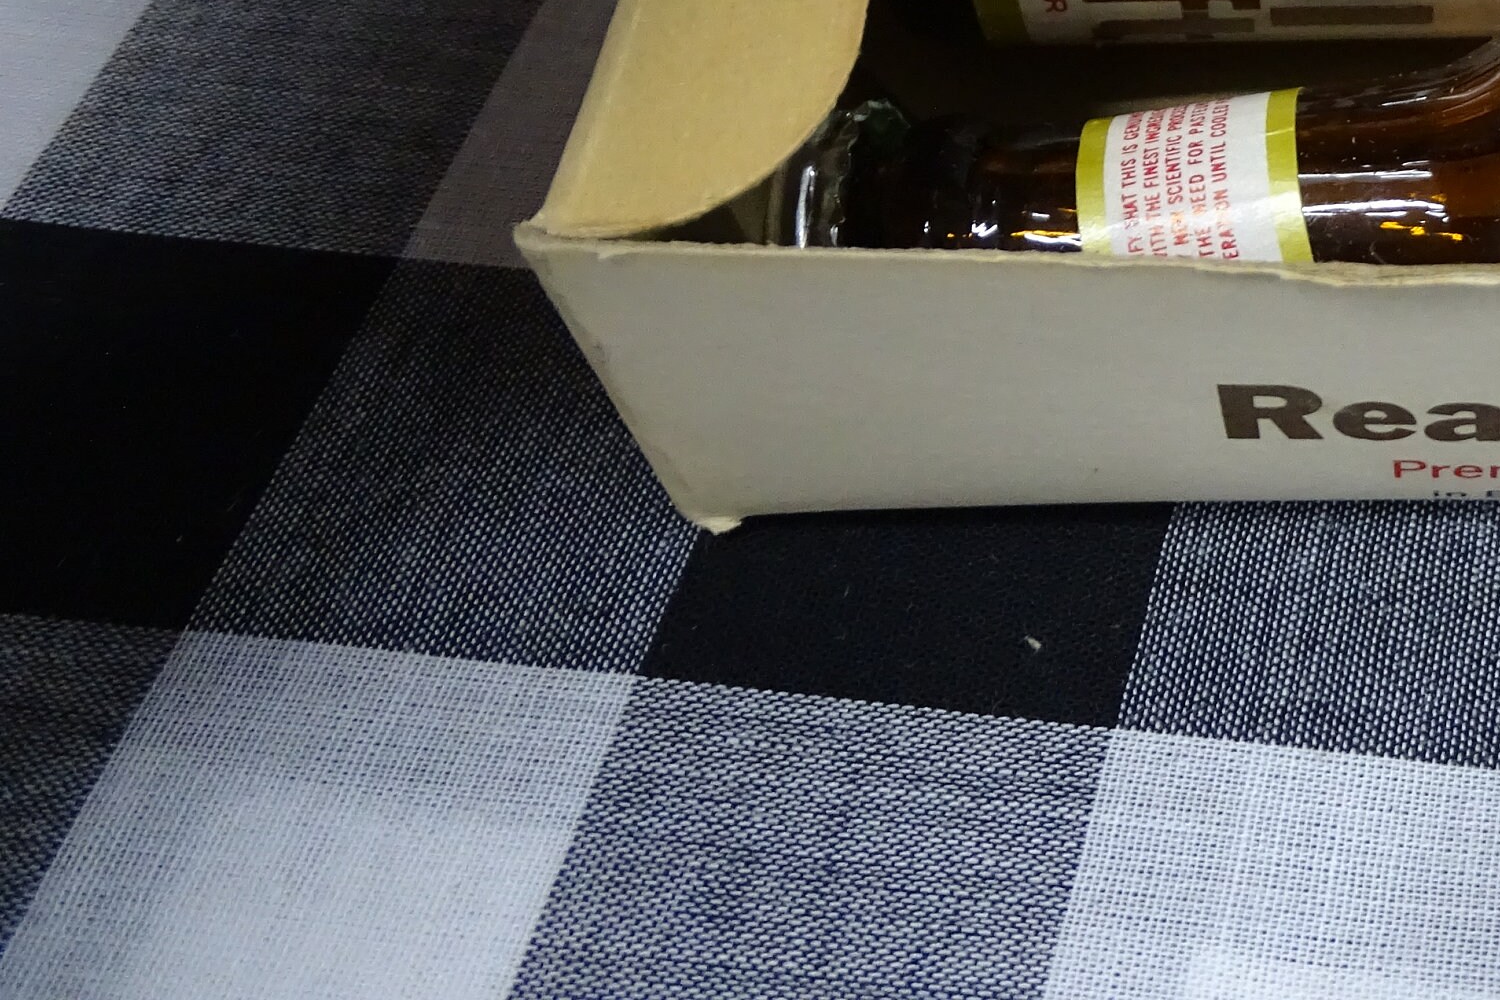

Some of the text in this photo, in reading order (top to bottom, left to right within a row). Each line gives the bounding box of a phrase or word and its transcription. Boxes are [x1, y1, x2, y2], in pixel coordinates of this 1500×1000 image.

[1210, 104, 1229, 137] COOLED
[1121, 143, 1139, 155] IS
[1187, 140, 1204, 165] FOR
[1209, 141, 1227, 182] UNTIL
[1120, 158, 1137, 188] THIS
[1143, 147, 1160, 189] FINEST
[1165, 134, 1183, 205] SCIENTIFIC
[1145, 192, 1161, 220] THE
[1189, 174, 1207, 215] NEED
[1195, 226, 1215, 257] THE
